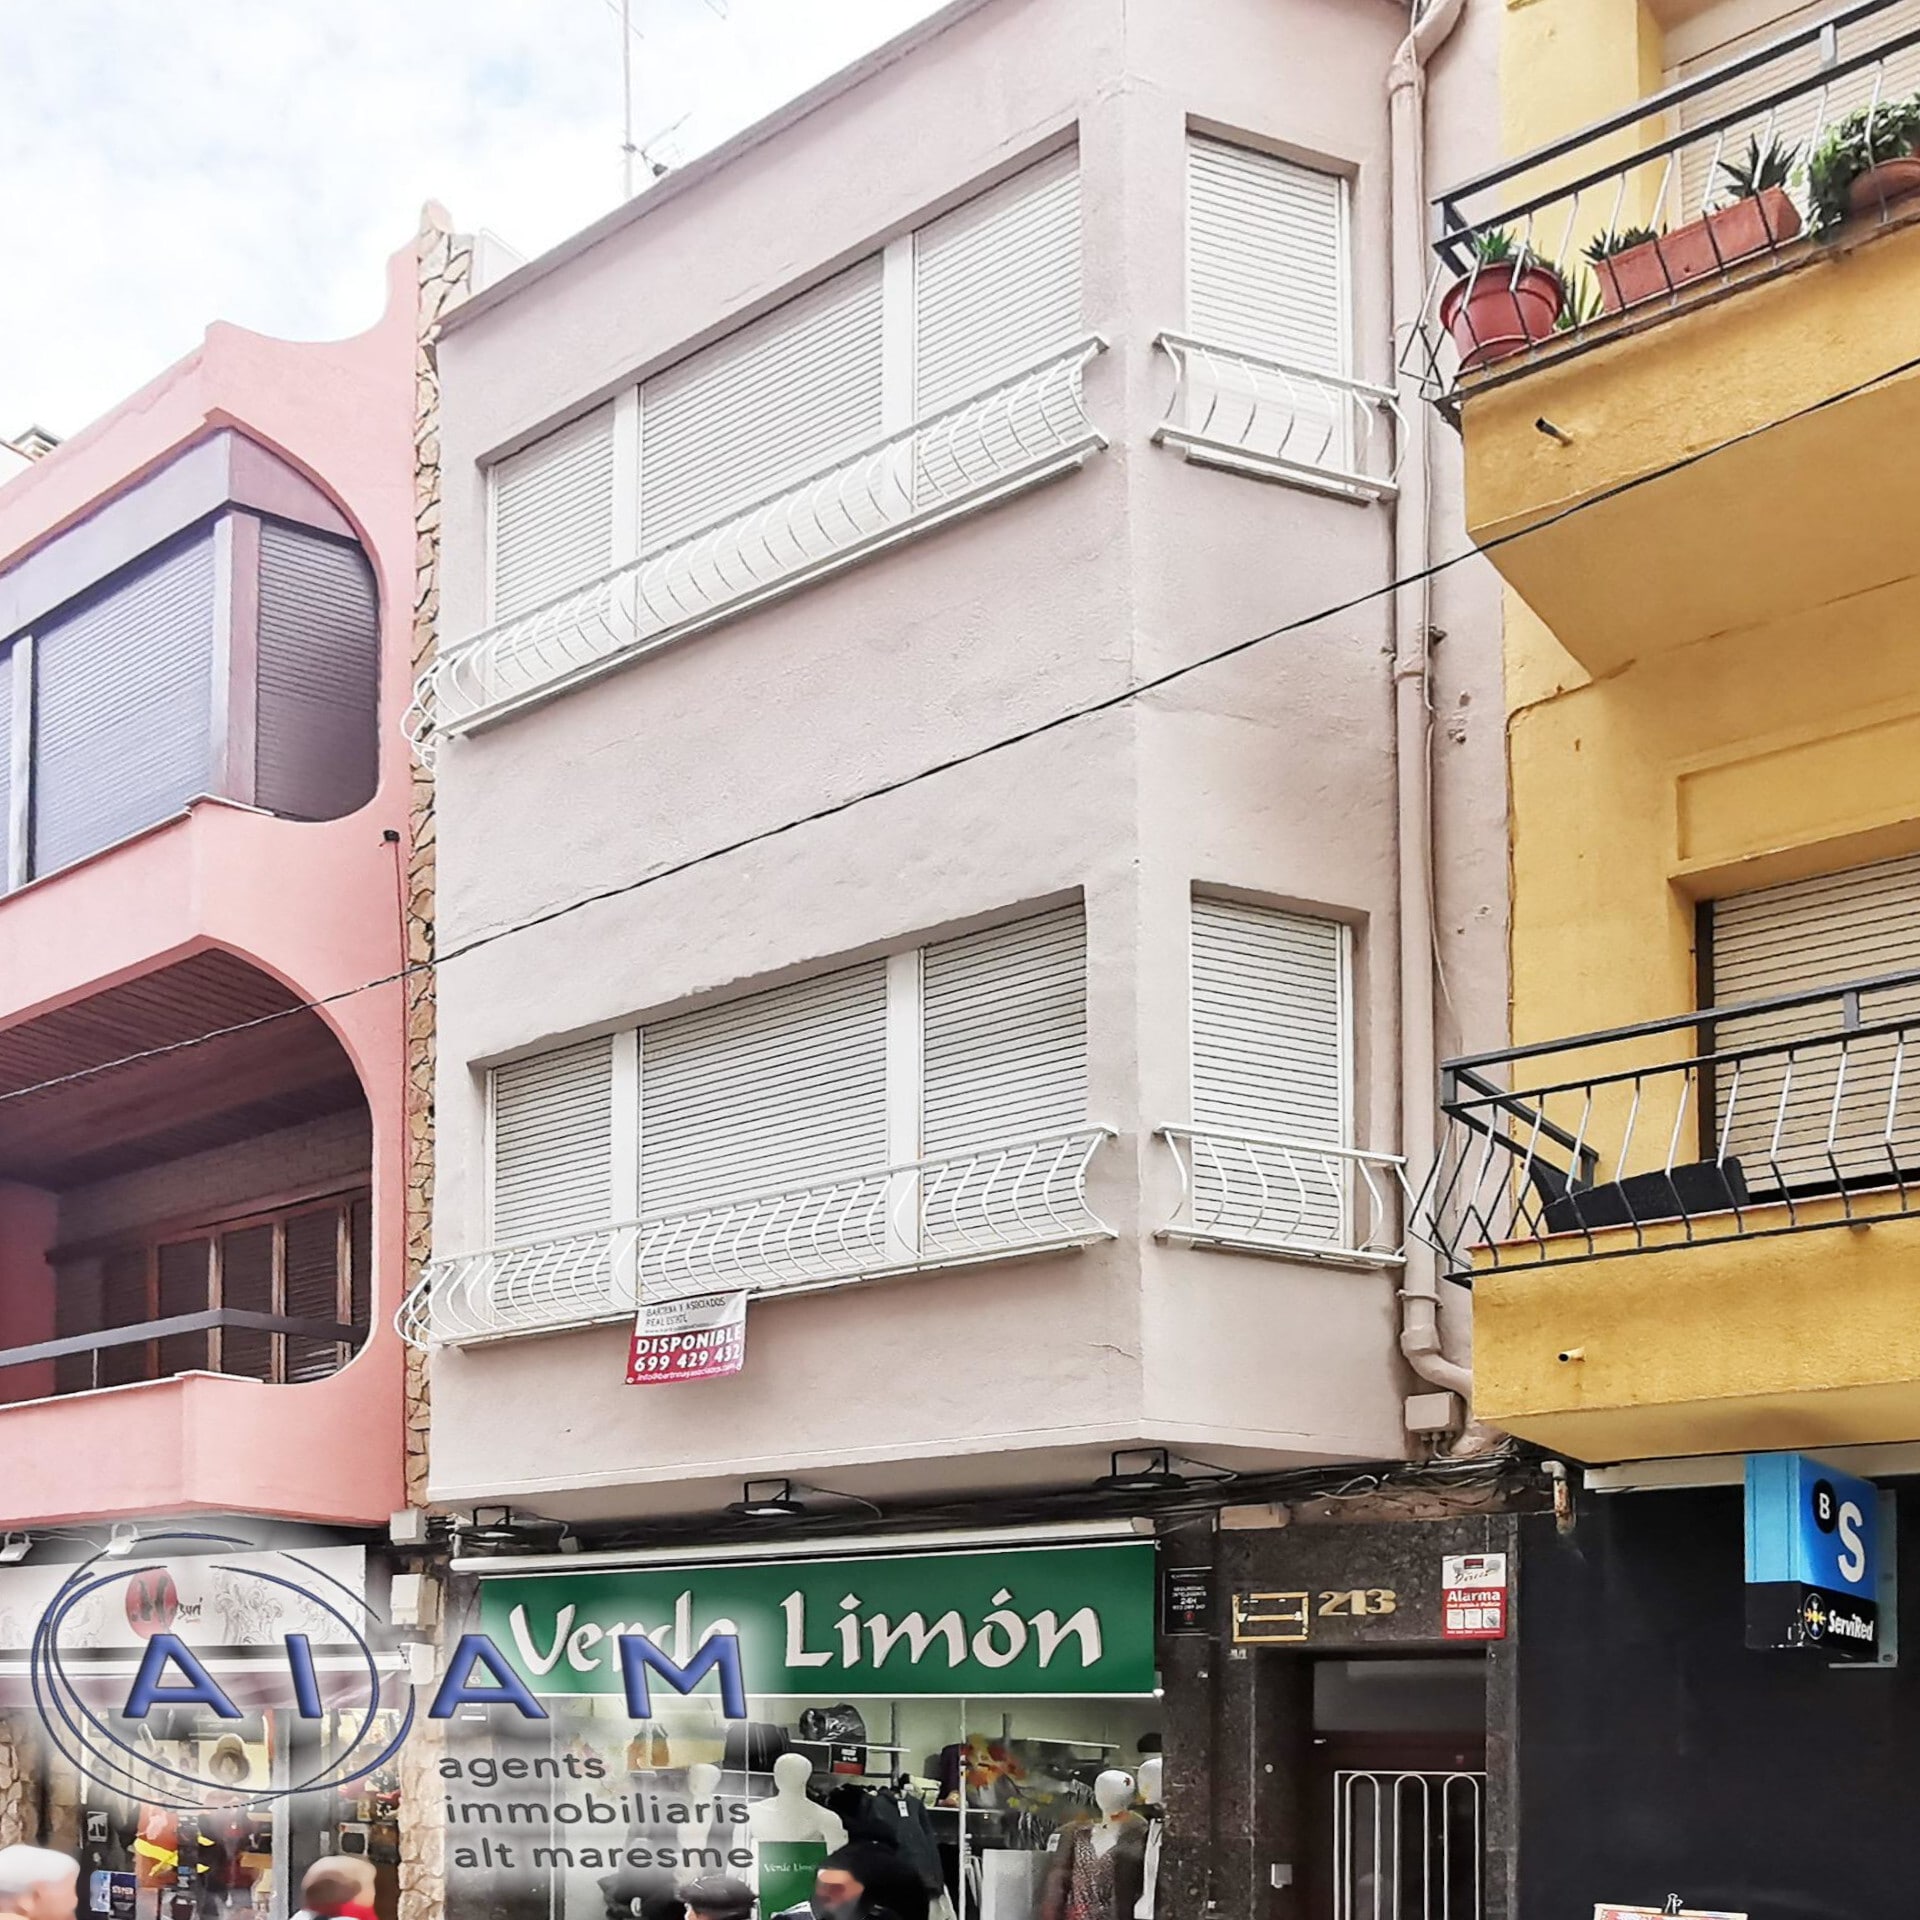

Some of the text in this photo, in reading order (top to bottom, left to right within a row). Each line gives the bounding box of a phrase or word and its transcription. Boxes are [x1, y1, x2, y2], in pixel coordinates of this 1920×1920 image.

[646, 1316, 665, 1327] REAL
[636, 1325, 742, 1355] DISPONIBLE
[634, 1355, 670, 1372] 699
[677, 1350, 709, 1368] 429
[1819, 1493, 1865, 1583] B S
[1318, 1588, 1397, 1616] 213
[1446, 1590, 1501, 1602] Alarma
[780, 1588, 1102, 1669] Limón
[1828, 1610, 1875, 1641] ServiRed
